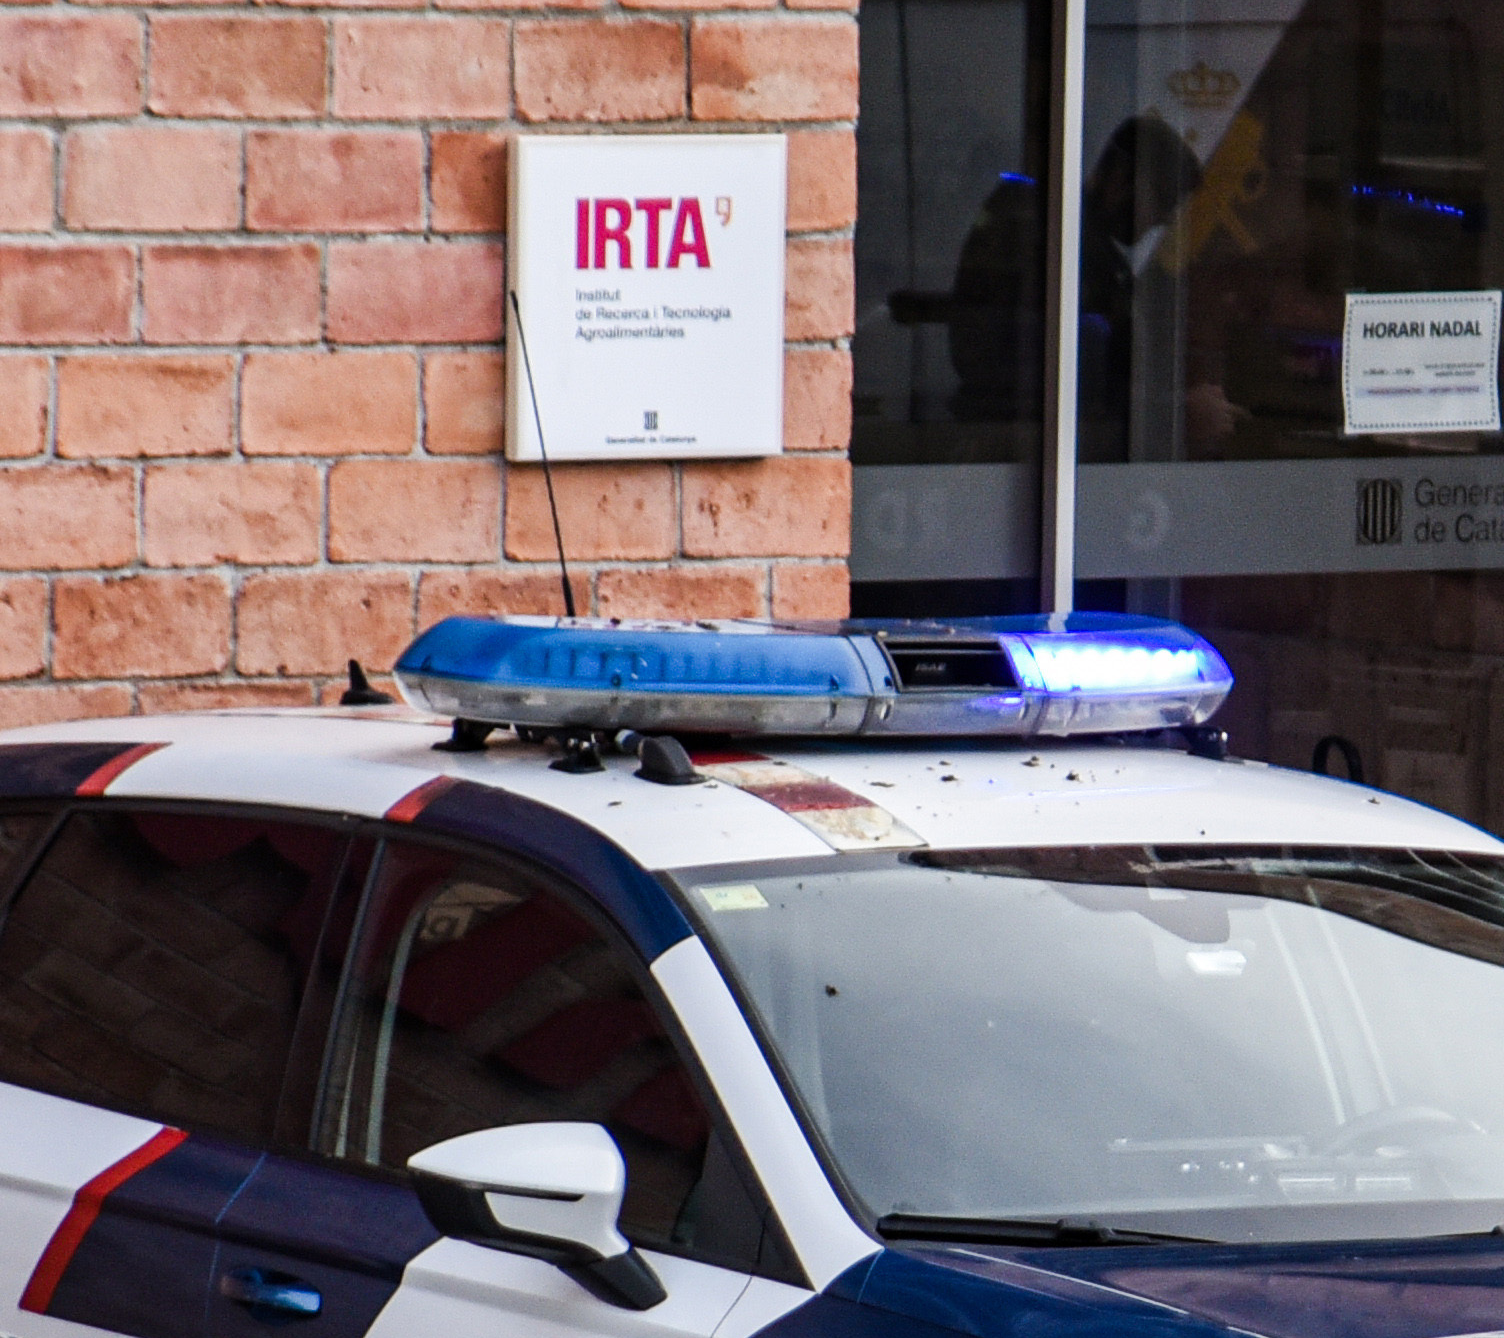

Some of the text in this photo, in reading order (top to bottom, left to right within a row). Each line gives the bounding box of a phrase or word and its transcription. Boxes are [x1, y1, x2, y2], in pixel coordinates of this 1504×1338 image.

[575, 197, 711, 270] IRTA
[575, 289, 621, 301] Institut
[575, 307, 592, 320] de
[596, 307, 650, 320] Recerca
[1363, 320, 1483, 338] HORARI NADAL
[1414, 515, 1445, 543] de
